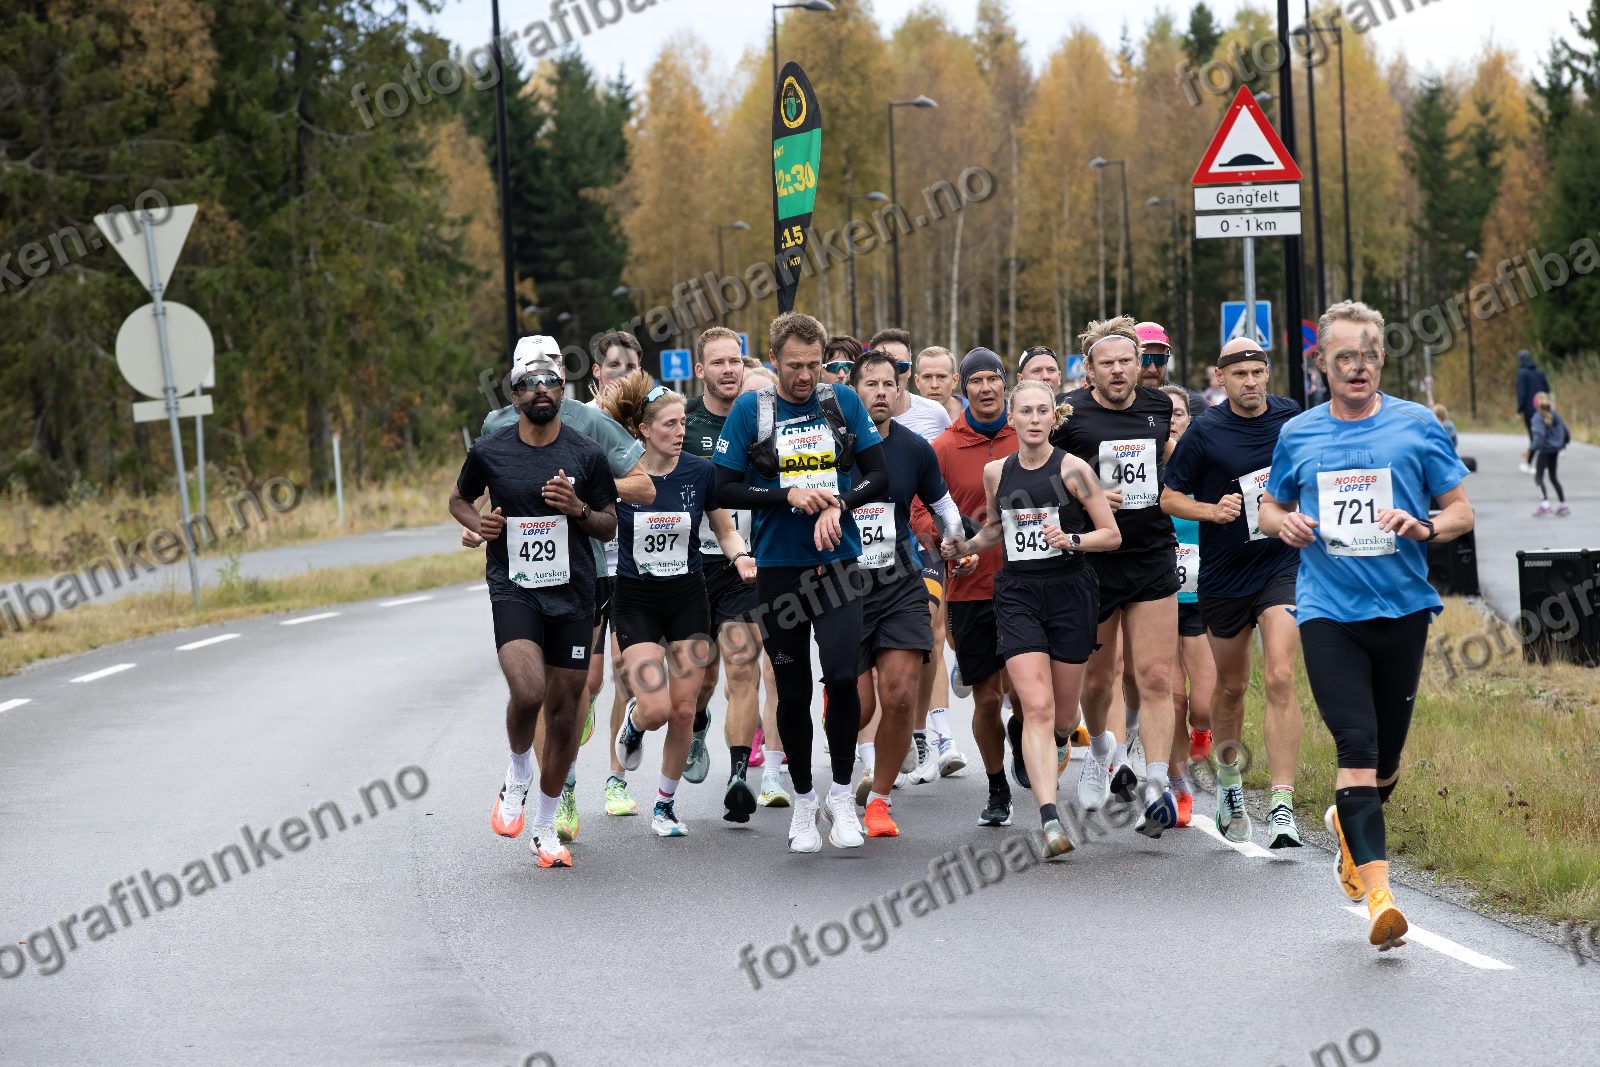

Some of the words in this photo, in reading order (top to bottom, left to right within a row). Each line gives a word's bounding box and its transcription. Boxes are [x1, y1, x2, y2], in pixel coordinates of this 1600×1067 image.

[777, 161, 816, 197] 2:30
[1216, 190, 1280, 206] Gangfelt
[1220, 220, 1230, 232] 0
[1245, 219, 1250, 231] 1
[1255, 218, 1277, 231] km
[786, 424, 829, 434] CELTMA
[788, 435, 823, 446] NORGES
[1112, 444, 1146, 452] NORGES
[1111, 463, 1147, 484] 464
[1254, 472, 1270, 484] NOR
[1334, 475, 1378, 486] NORGES
[1339, 483, 1371, 493] LØPET
[1125, 492, 1157, 501] Aurskog
[853, 507, 885, 515] NORGES
[1014, 512, 1048, 521] NORGES
[1333, 498, 1375, 526] 721
[519, 521, 557, 529] NORGES
[647, 516, 682, 524] NORGES
[522, 528, 551, 536] LØPET
[862, 526, 885, 545] 54
[644, 533, 680, 553] 397
[1015, 531, 1050, 553] 943
[1351, 536, 1393, 547] Aurskog
[519, 539, 556, 562] 429
[657, 560, 686, 568] Aurskog
[533, 570, 568, 579] Aurskog
